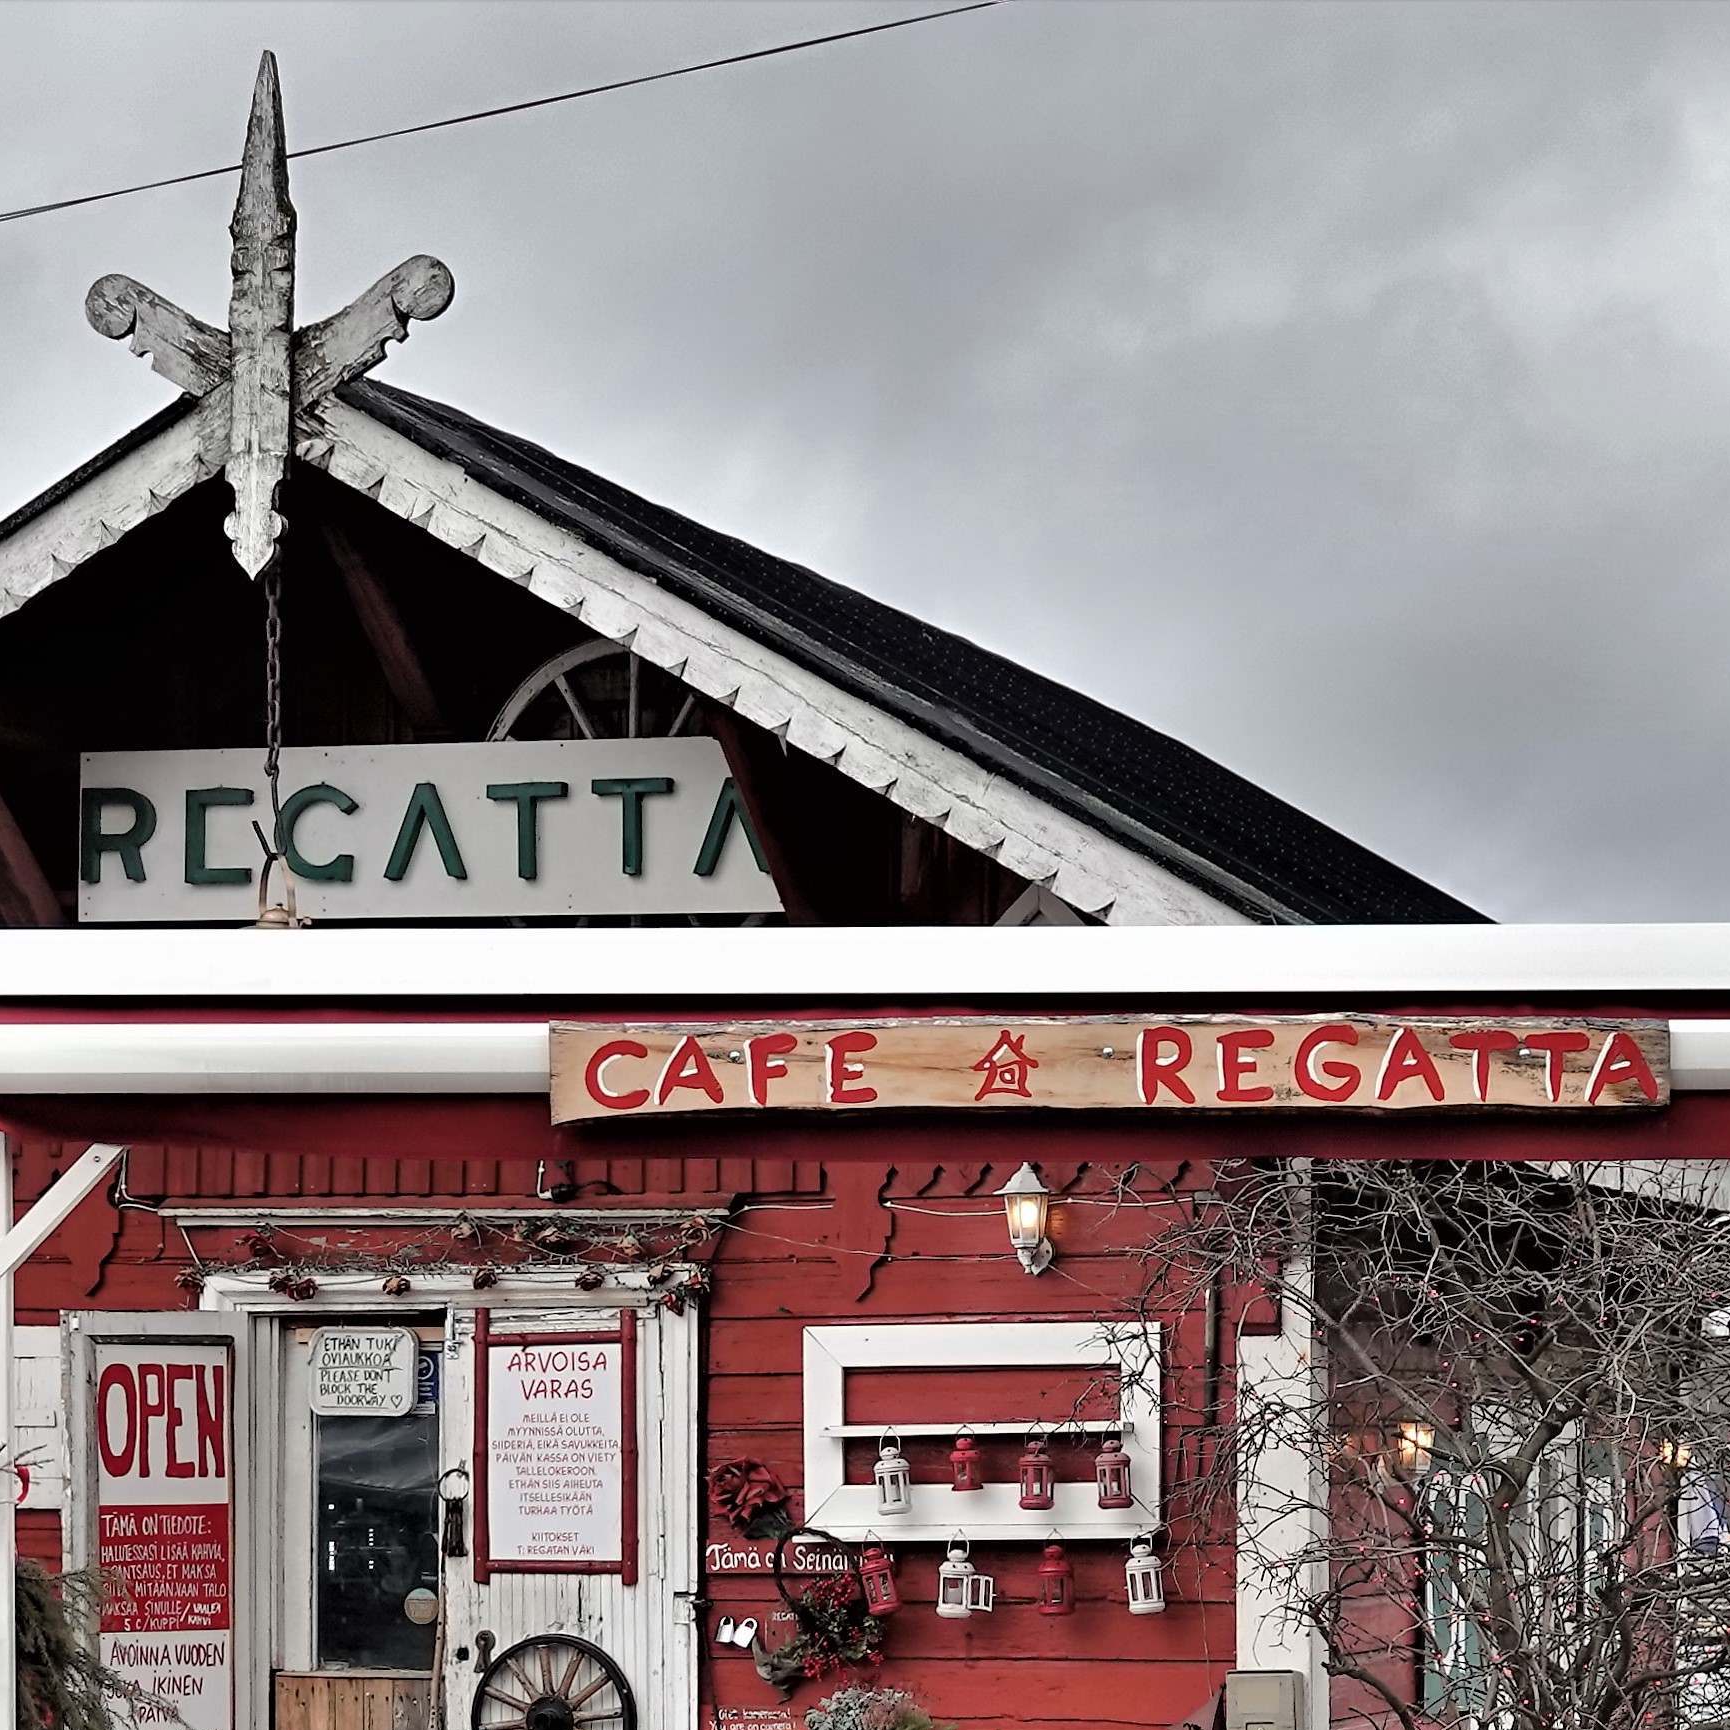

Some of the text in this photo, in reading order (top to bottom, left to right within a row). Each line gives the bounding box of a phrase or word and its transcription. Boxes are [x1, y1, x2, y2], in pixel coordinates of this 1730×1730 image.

[80, 776, 773, 887] REGATTA
[584, 1024, 1659, 1110] CAFE REGATTA
[322, 1352, 393, 1367] OVIAUKKOA
[507, 1351, 608, 1374] ARVOISA
[320, 1370, 359, 1383] PLEASE
[319, 1383, 378, 1396] BLOCK THE
[520, 1378, 594, 1401] VARAS
[337, 1394, 386, 1407] DOORWAY
[97, 1363, 226, 1478] OPEN
[523, 1411, 590, 1423] MEILLÄ EI OLE
[507, 1425, 563, 1437] MYYNNISSÄ
[496, 1451, 616, 1463] PÄIVÄN KASSA ON VIETY
[509, 1478, 604, 1489] ETHÄN SIIS AIHEUTA
[519, 1506, 558, 1516] TURHAA
[100, 1511, 139, 1538] TÄMÄ
[141, 1513, 159, 1536] ON
[532, 1532, 579, 1542] KIITOKSET
[527, 1545, 570, 1555] REGATAN
[571, 1544, 595, 1555] VÄKI
[705, 1542, 762, 1572] Tämä
[182, 1563, 217, 1580] MAKSA
[202, 1582, 227, 1598] TALO
[124, 1618, 132, 1632] 5
[174, 1640, 225, 1668] VUODEN
[152, 1669, 204, 1696] IKINEN
